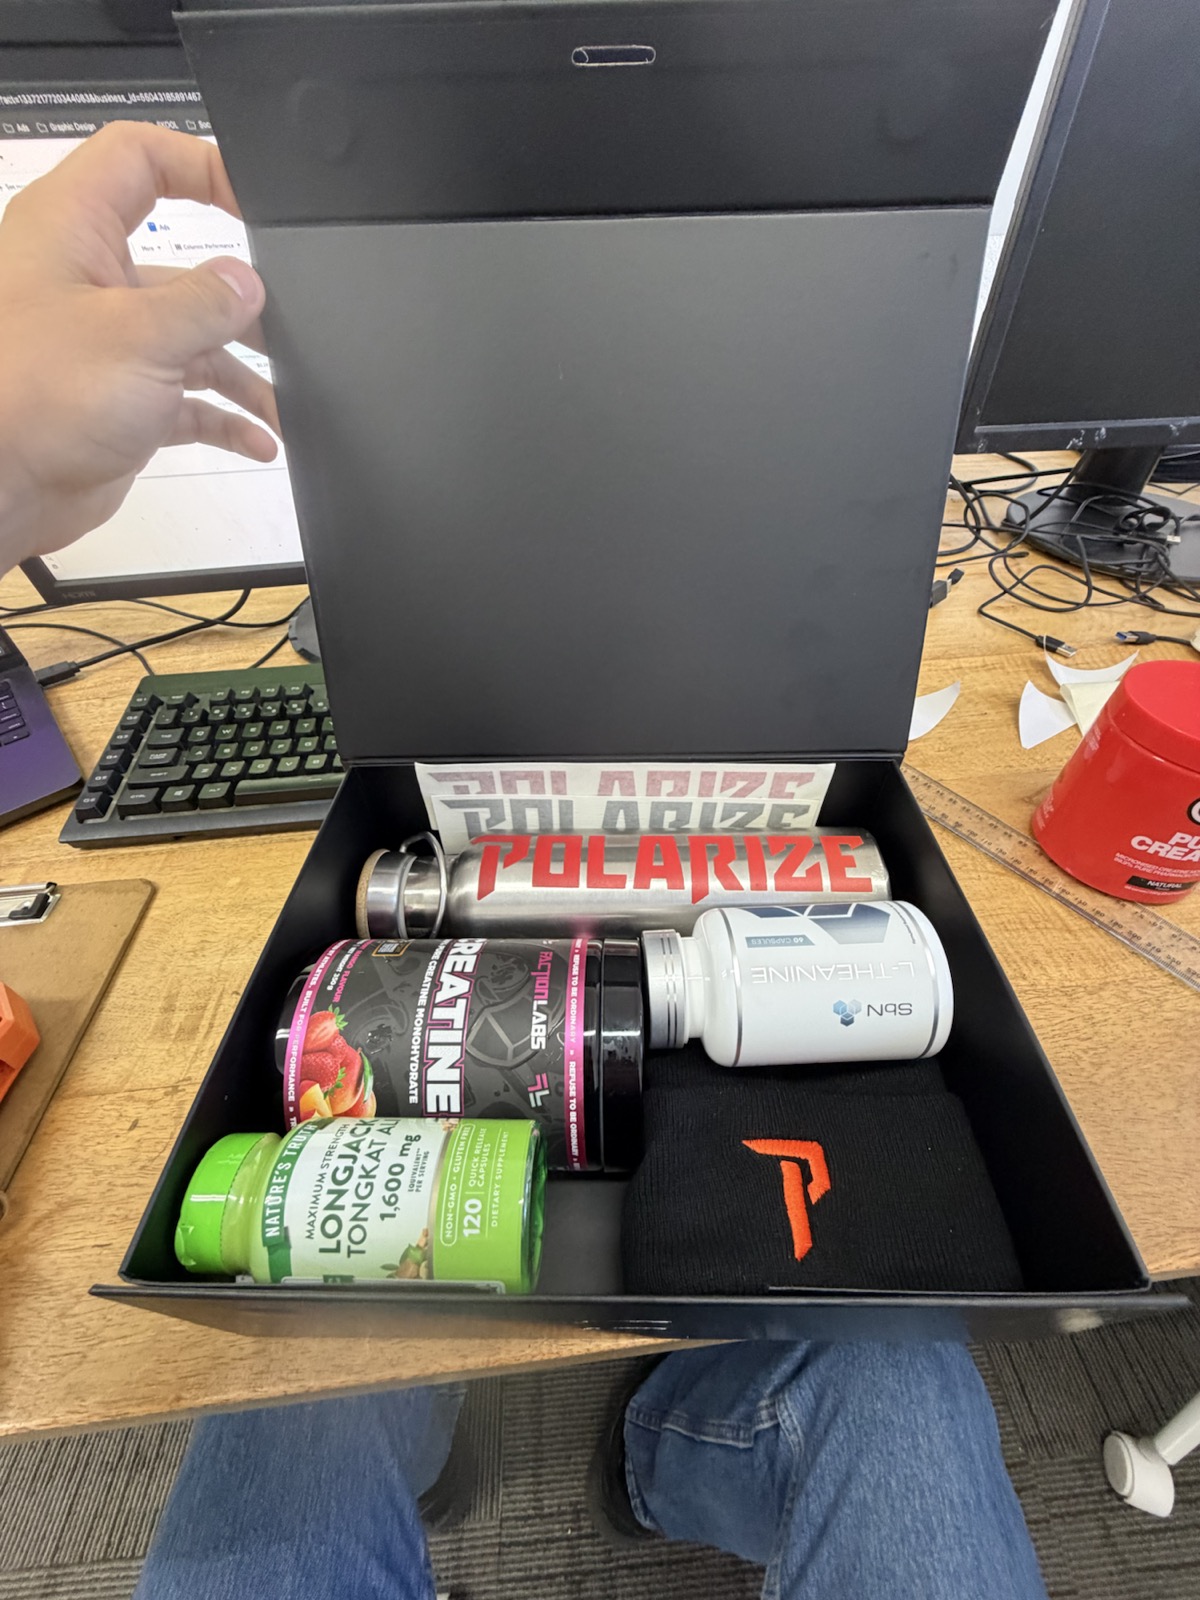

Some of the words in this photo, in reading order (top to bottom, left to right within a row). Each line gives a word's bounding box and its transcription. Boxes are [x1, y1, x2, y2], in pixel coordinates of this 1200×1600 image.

[470, 834, 874, 905] POLARIZE
[1131, 835, 1200, 863] CREA
[751, 937, 792, 946] CAPSULES
[332, 970, 350, 1003] FLAVOUR
[418, 960, 438, 1006] CREATINE
[570, 987, 578, 998] BE
[571, 976, 579, 986] TO
[750, 961, 915, 984] L-THEANINE
[300, 990, 313, 1012] BUILT
[569, 998, 578, 1043] ORDINARY
[866, 1002, 913, 1017] SbN
[288, 1034, 300, 1101] PERFORMANCE
[409, 1008, 425, 1104] MONOHYDRATE
[569, 1061, 577, 1097] REFUSE
[569, 1098, 577, 1110] TO
[569, 1111, 577, 1123] BE
[379, 1163, 405, 1221] 1,600
[399, 1134, 422, 1157] mg
[415, 1180, 423, 1193] PER
[419, 1150, 430, 1178] SERVING
[468, 1156, 480, 1187] QUICK
[474, 1128, 487, 1155] RELEASE
[477, 1143, 491, 1187] CAPSULES
[491, 1183, 501, 1227] DIETARY
[496, 1131, 508, 1180] SUPPLEMENT
[265, 1162, 292, 1238] NATURE'S
[282, 1122, 318, 1157] TRUTH
[305, 1172, 327, 1240] MAXIMUM
[320, 1123, 350, 1170] STRENGTH
[319, 1119, 379, 1253] LONGJACK
[347, 1139, 387, 1259] TONGKAT
[445, 1183, 457, 1238] NON-GMO
[453, 1139, 466, 1173] GLUTEN
[461, 1126, 471, 1140] FREE
[463, 1198, 482, 1238] 120
